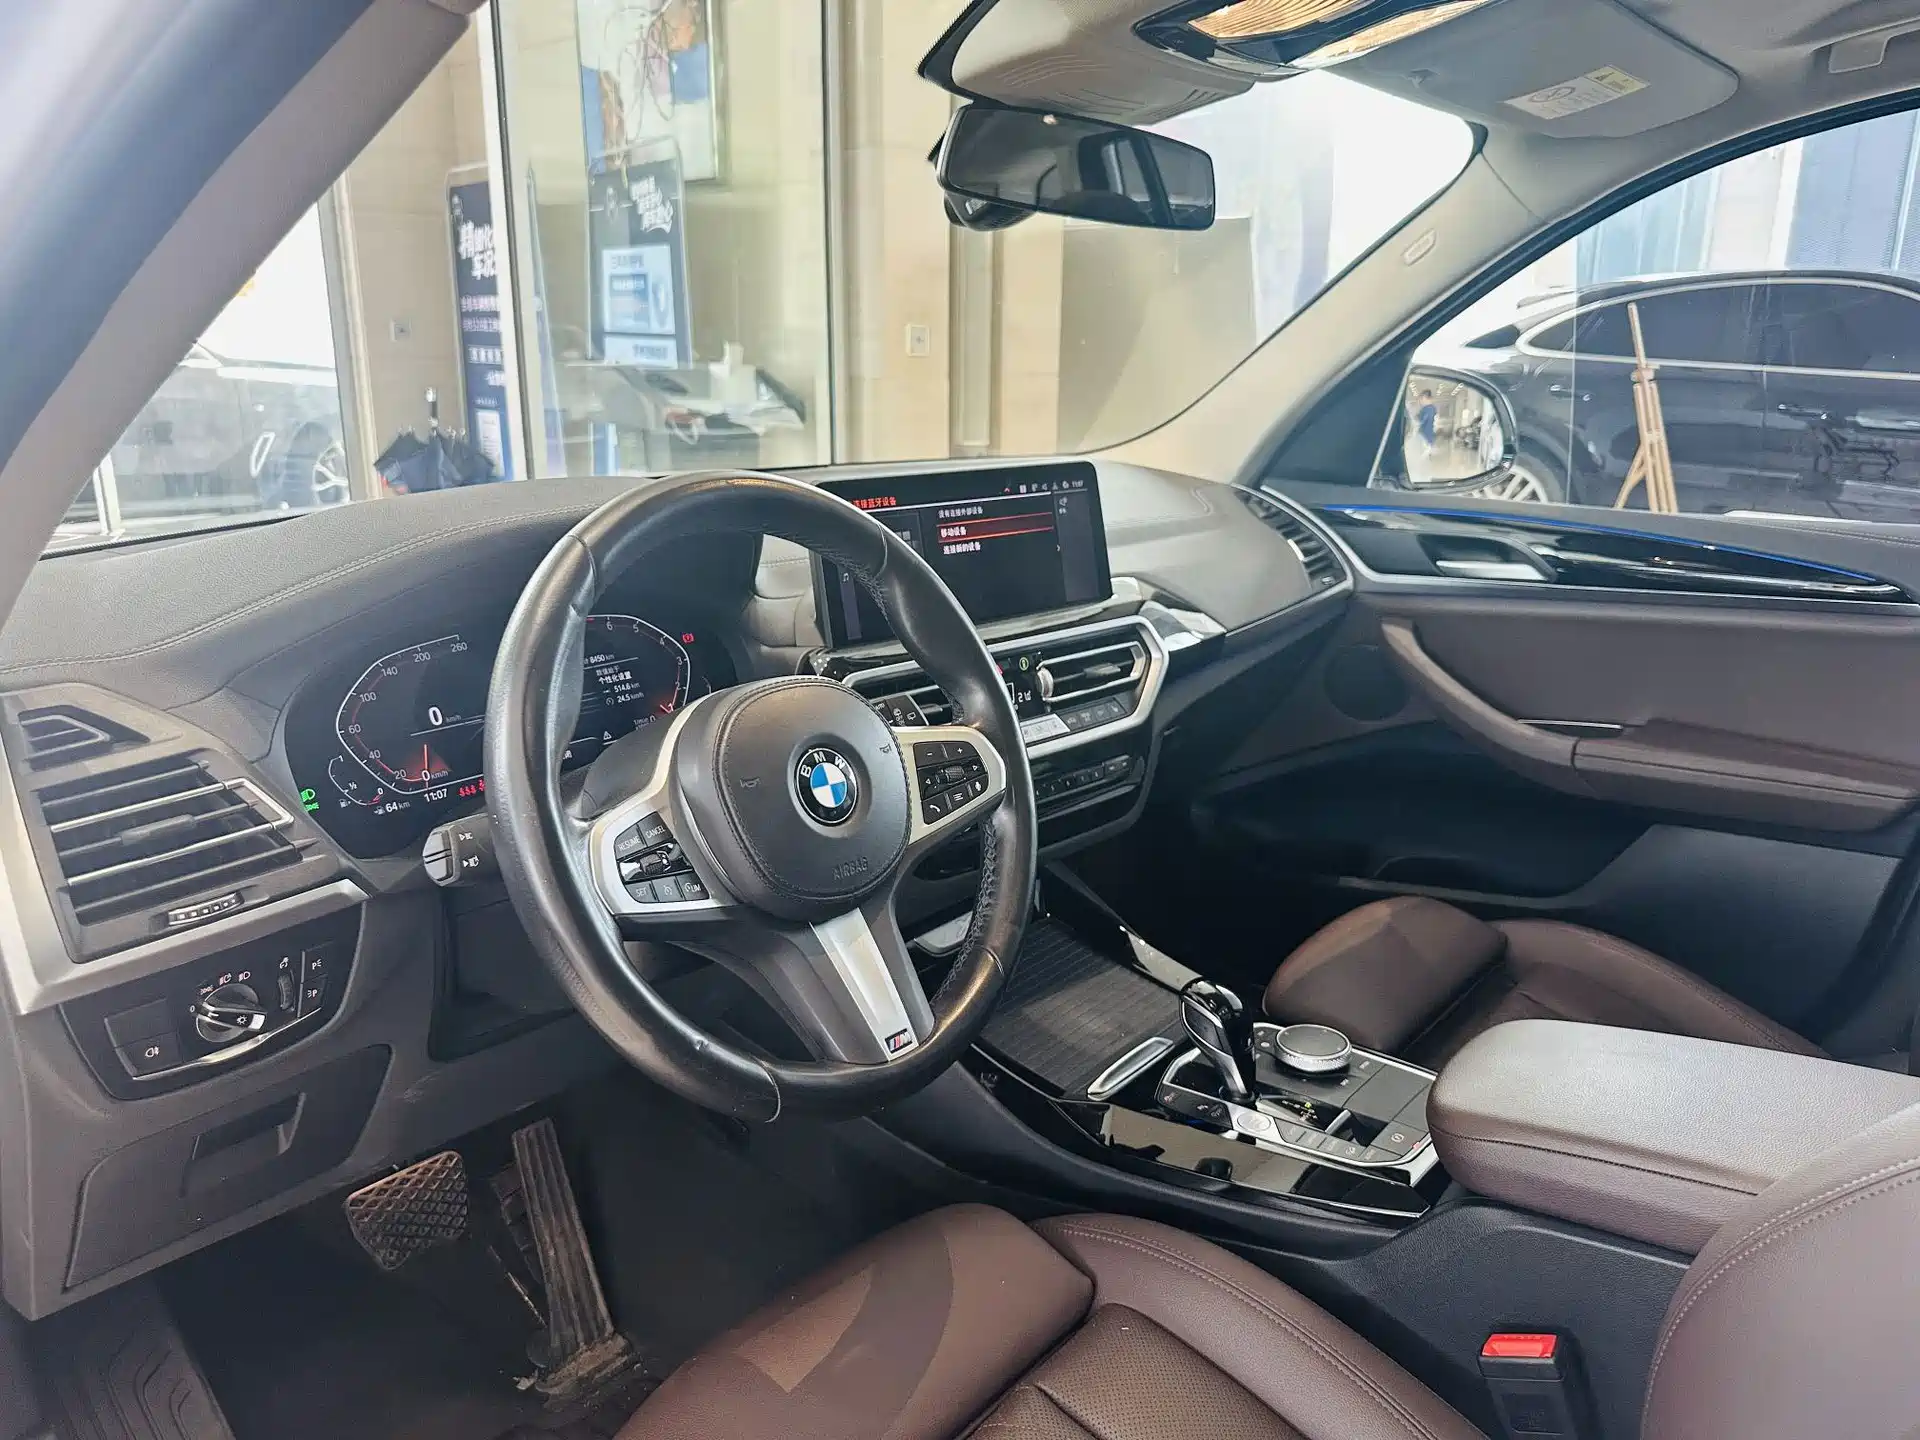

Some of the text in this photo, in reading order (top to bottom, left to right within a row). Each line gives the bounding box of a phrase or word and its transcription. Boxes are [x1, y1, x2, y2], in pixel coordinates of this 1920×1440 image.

[606, 621, 613, 631] 6
[632, 624, 639, 633] 5
[450, 642, 468, 653] 260
[660, 638, 665, 646] 4
[413, 652, 431, 663] 200
[676, 656, 683, 666] 3
[381, 666, 398, 677] 140
[675, 681, 681, 690] 2
[360, 692, 377, 703] 100
[428, 706, 443, 726] 0
[348, 724, 361, 734] 60
[368, 750, 381, 760] 40
[800, 751, 846, 778] BMW
[394, 769, 407, 780] 20
[421, 769, 449, 781] 0 km/h
[377, 787, 384, 795] 0
[424, 789, 448, 802] 11:07
[385, 801, 411, 813] 64 km
[645, 825, 666, 839] CANCEL
[618, 836, 641, 850] RESUME
[832, 856, 869, 881] AIRBAG
[635, 887, 648, 897] SET
